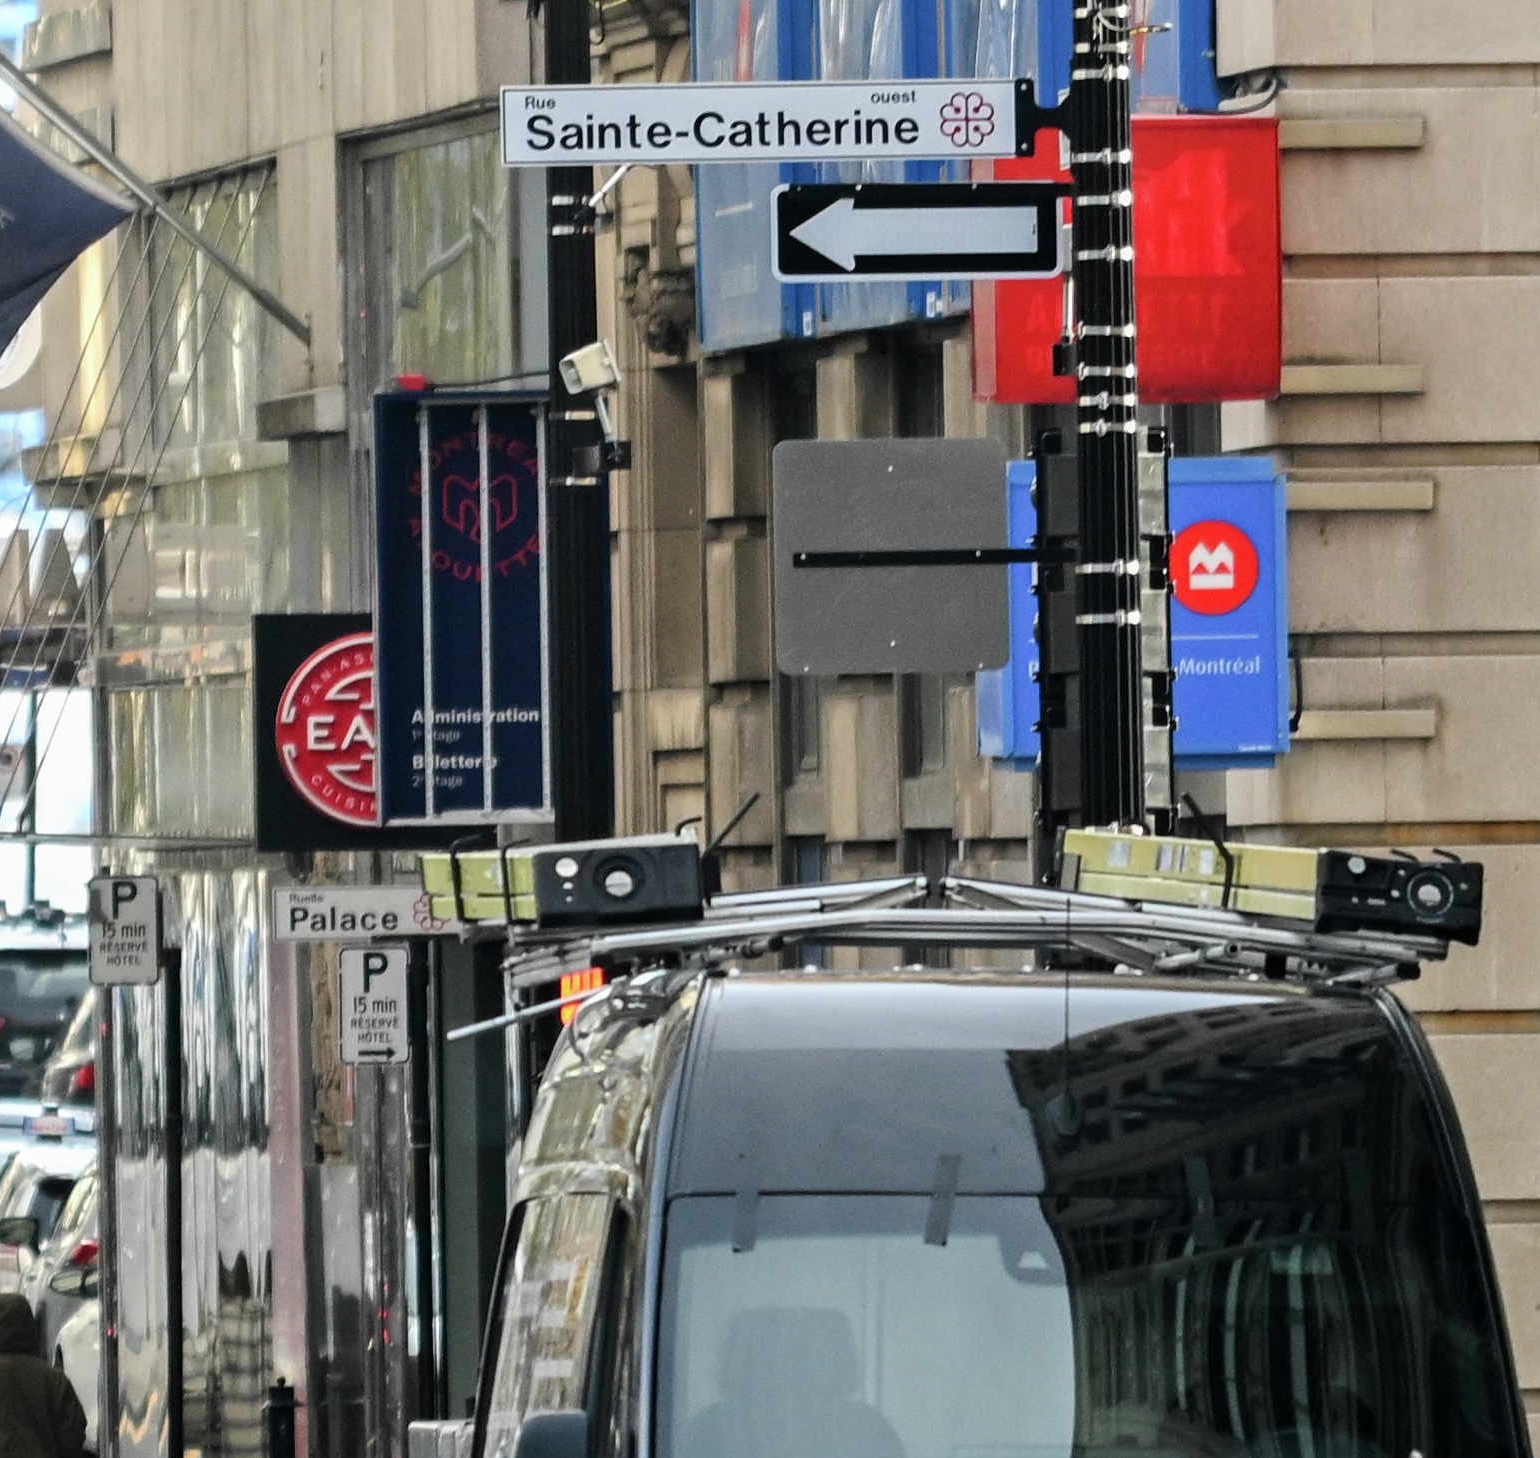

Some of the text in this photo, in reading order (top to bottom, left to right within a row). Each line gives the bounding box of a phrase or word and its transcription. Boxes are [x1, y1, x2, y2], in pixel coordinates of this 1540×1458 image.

[524, 96, 556, 111] Rue
[870, 91, 917, 105] ouest
[526, 110, 920, 151] Sainte-Catherine
[1179, 656, 1261, 676] Montréal
[112, 881, 137, 920] P
[290, 907, 398, 932] Palace
[121, 922, 146, 938] min
[363, 952, 388, 993] P
[353, 996, 397, 1014] 15 min
